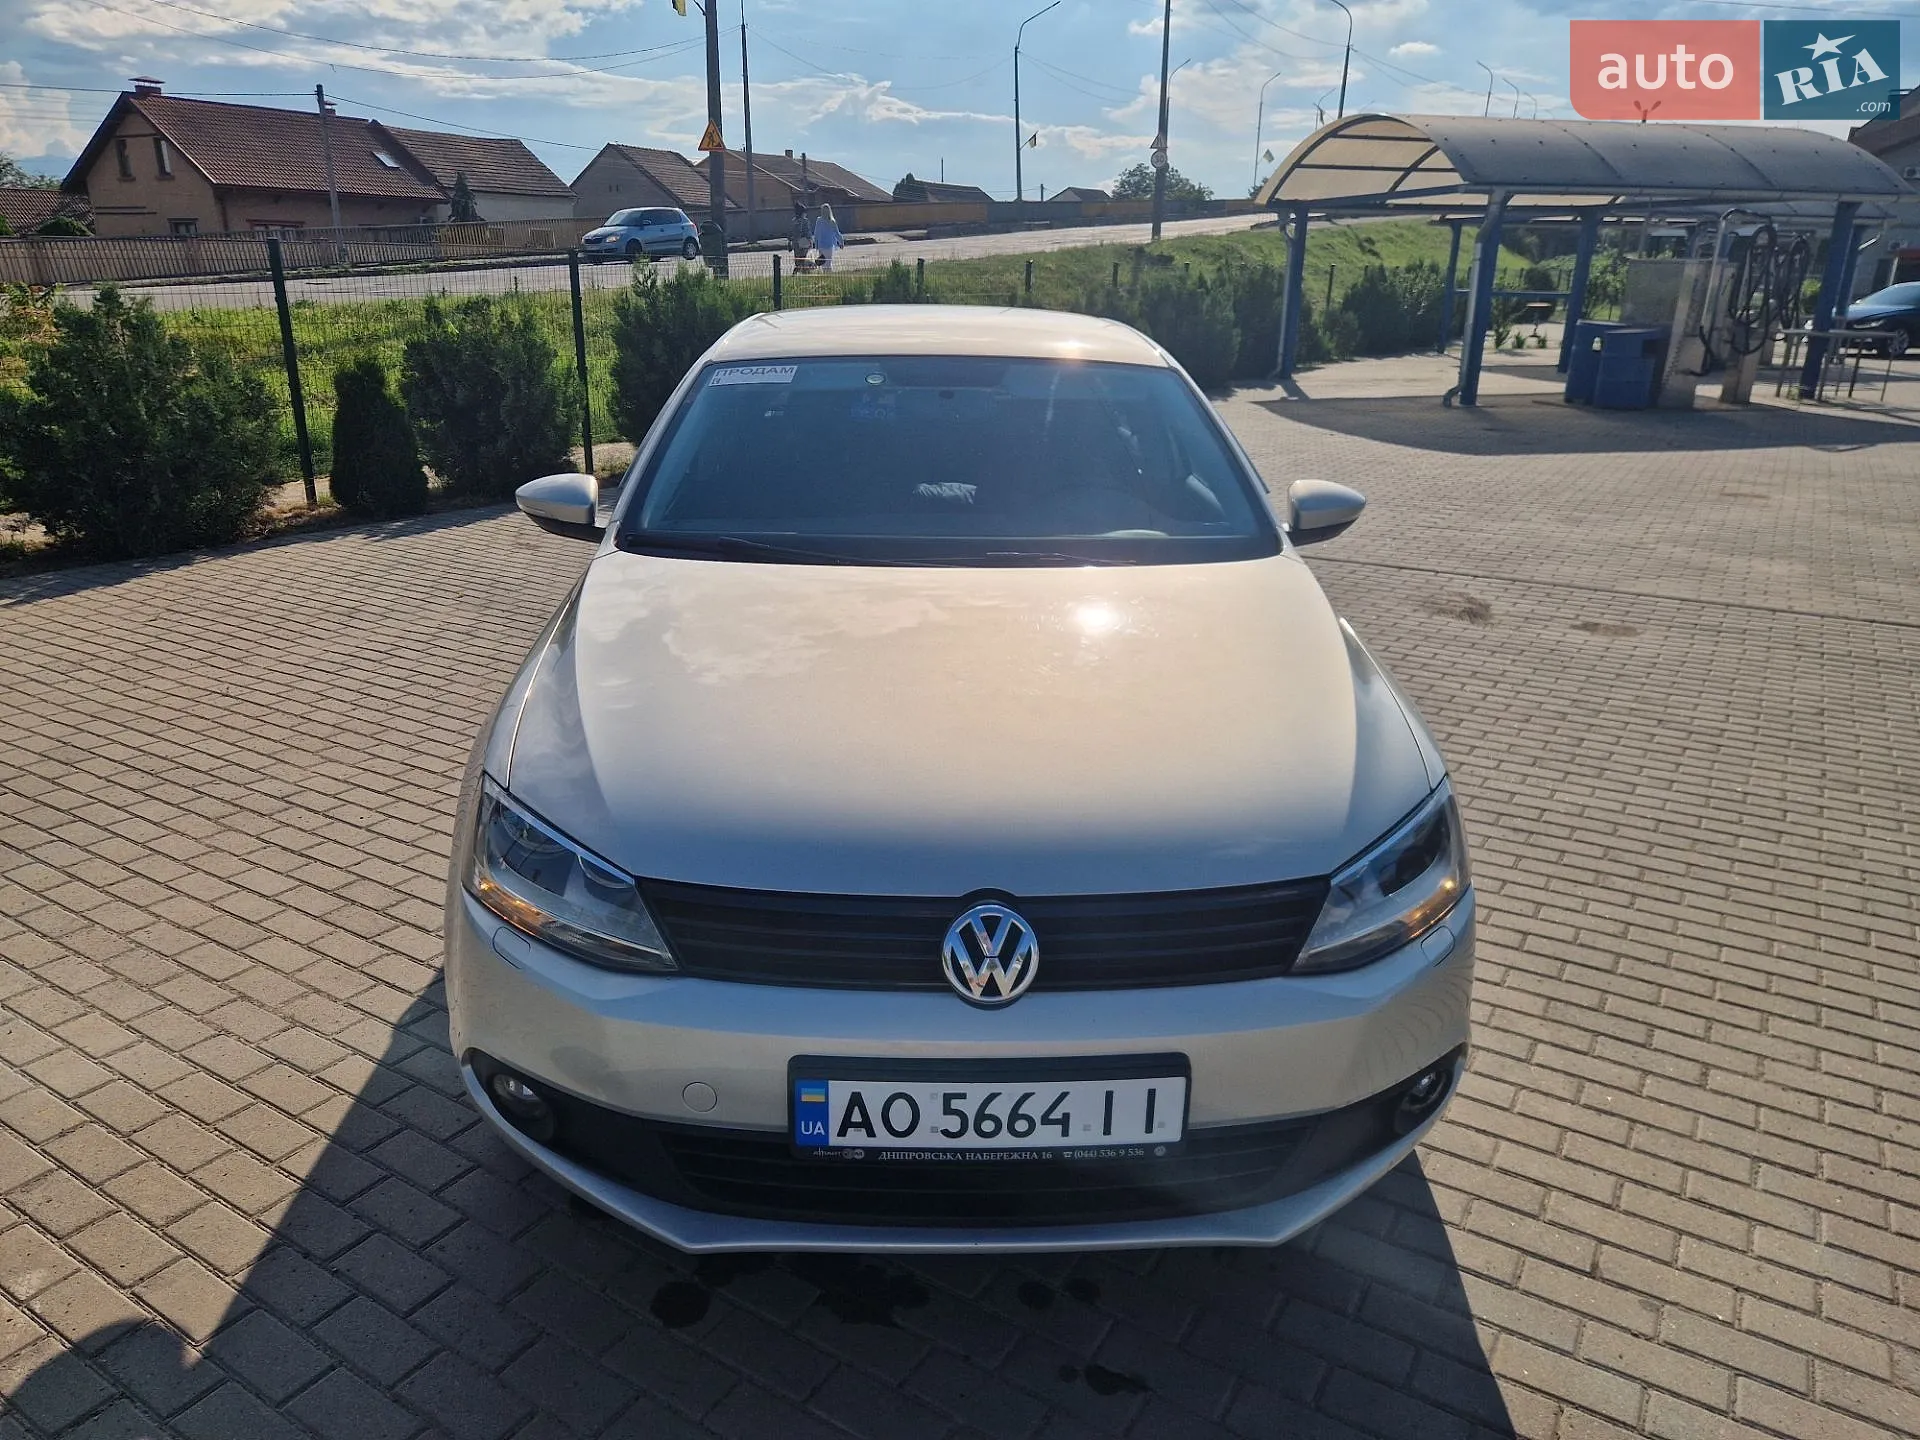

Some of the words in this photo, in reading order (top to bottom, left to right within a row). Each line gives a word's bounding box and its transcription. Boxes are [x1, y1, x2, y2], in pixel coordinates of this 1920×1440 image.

[715, 366, 794, 377] ПРОДАМ
[836, 1091, 921, 1138] AO
[940, 1091, 1071, 1139] 5664
[801, 1121, 825, 1136] UA
[879, 1151, 962, 1160] ДНІПРОВСЬКА
[965, 1151, 1038, 1160] НАБЕРЕЖНА
[1042, 1151, 1052, 1160] 16
[1074, 1150, 1097, 1159] (044)
[1100, 1149, 1116, 1158] 536
[1119, 1149, 1124, 1157] 9
[1128, 1148, 1144, 1157] 536
